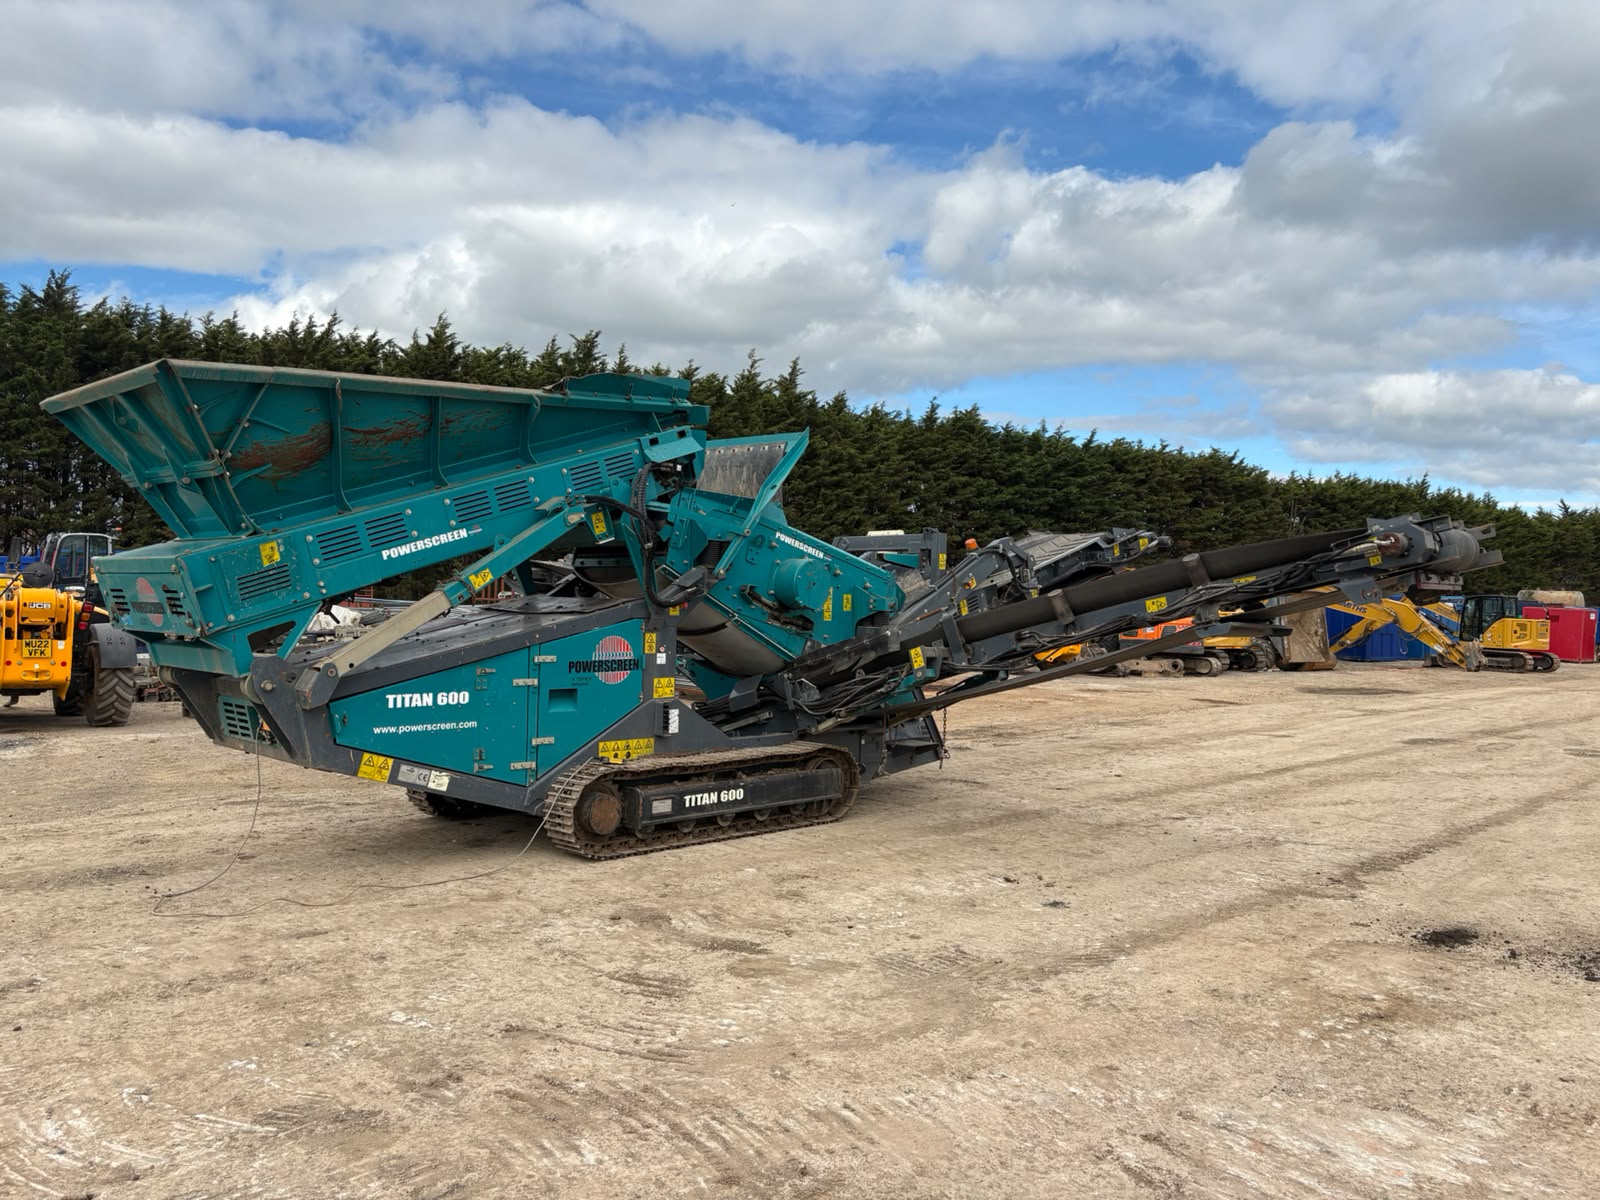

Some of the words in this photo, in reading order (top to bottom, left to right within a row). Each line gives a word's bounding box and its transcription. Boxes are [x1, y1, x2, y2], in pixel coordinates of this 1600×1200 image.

[381, 528, 468, 560] POWERSCREEN
[775, 531, 824, 559] POWERSCREEN
[568, 658, 639, 673] POWERSCREEN
[385, 692, 433, 709] TITAN
[436, 691, 469, 706] 600
[373, 721, 477, 735] www.powerscreen.com
[683, 791, 718, 808] TITAN
[720, 788, 744, 802] 600
